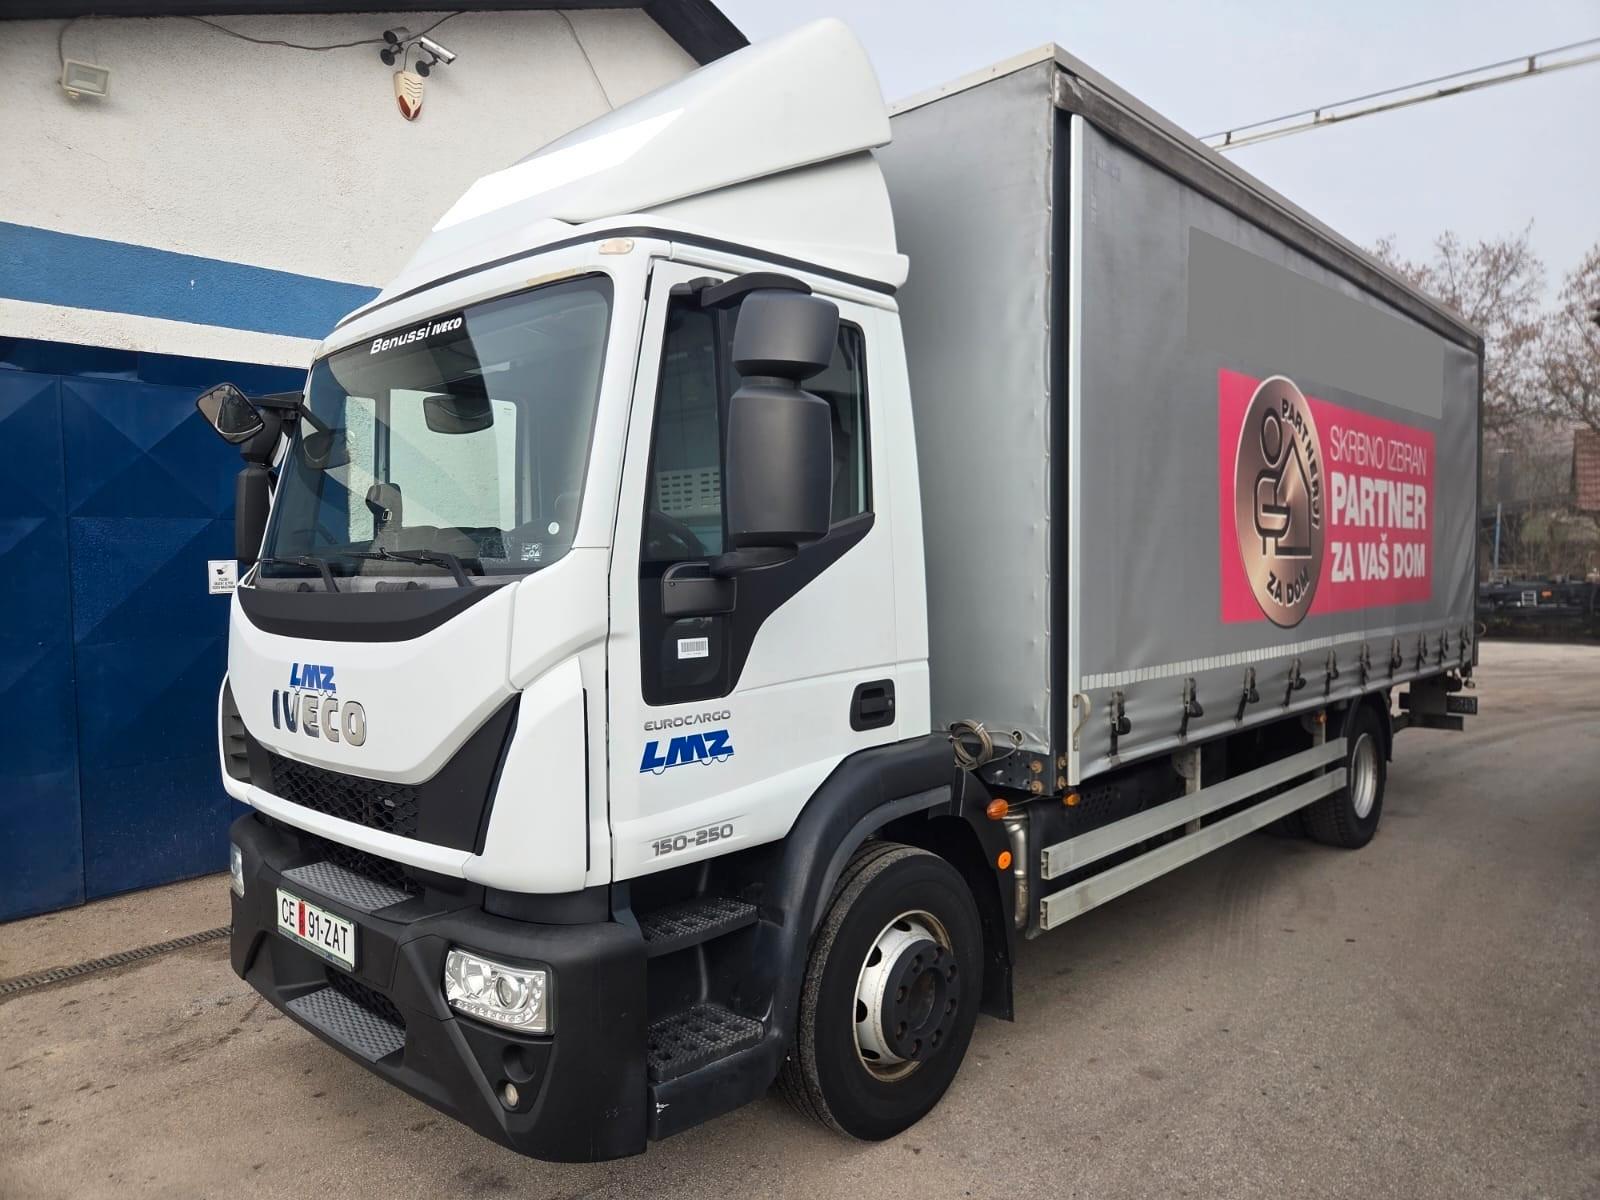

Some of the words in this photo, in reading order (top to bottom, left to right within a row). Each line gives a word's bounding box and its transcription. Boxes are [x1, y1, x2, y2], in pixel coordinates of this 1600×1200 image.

[370, 321, 431, 354] Benussi
[431, 317, 462, 335] IVECO
[1330, 425, 1385, 469] SKRBNO
[1387, 440, 1426, 476] IZBRAN
[1331, 471, 1426, 529] PARTNER
[1331, 541, 1354, 582] ZA
[1358, 533, 1389, 580] VAŠ
[1393, 543, 1425, 578] DOM
[1266, 570, 1283, 605] ZA
[1286, 567, 1310, 606] DOM
[290, 662, 337, 692] LMZ
[272, 689, 367, 747] IVECO
[644, 710, 731, 731] EUROCARGO
[640, 729, 734, 772] LMZ
[652, 824, 733, 856] 150-250
[282, 898, 295, 927] CE
